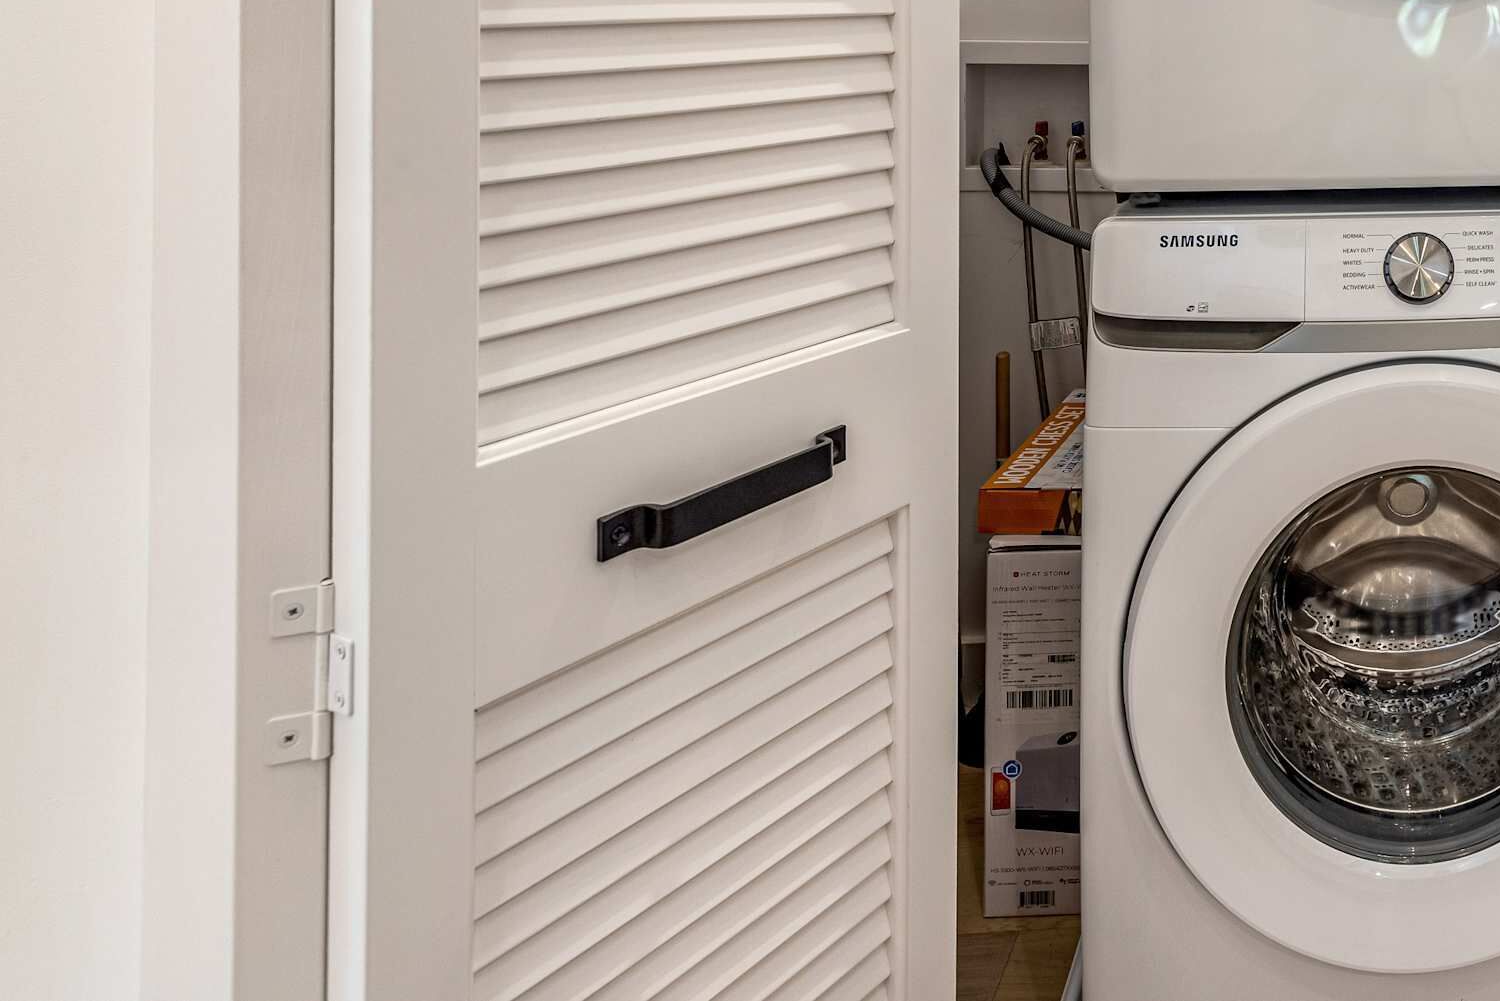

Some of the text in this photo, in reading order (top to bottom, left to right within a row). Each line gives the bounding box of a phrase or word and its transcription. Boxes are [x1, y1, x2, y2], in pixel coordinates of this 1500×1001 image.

[1160, 234, 1239, 248] SAMSUNG
[993, 447, 1052, 484] WOODEN
[1031, 420, 1075, 446] CHESS
[1055, 405, 1085, 420] SET
[1016, 847, 1064, 857] WX-WIFI
